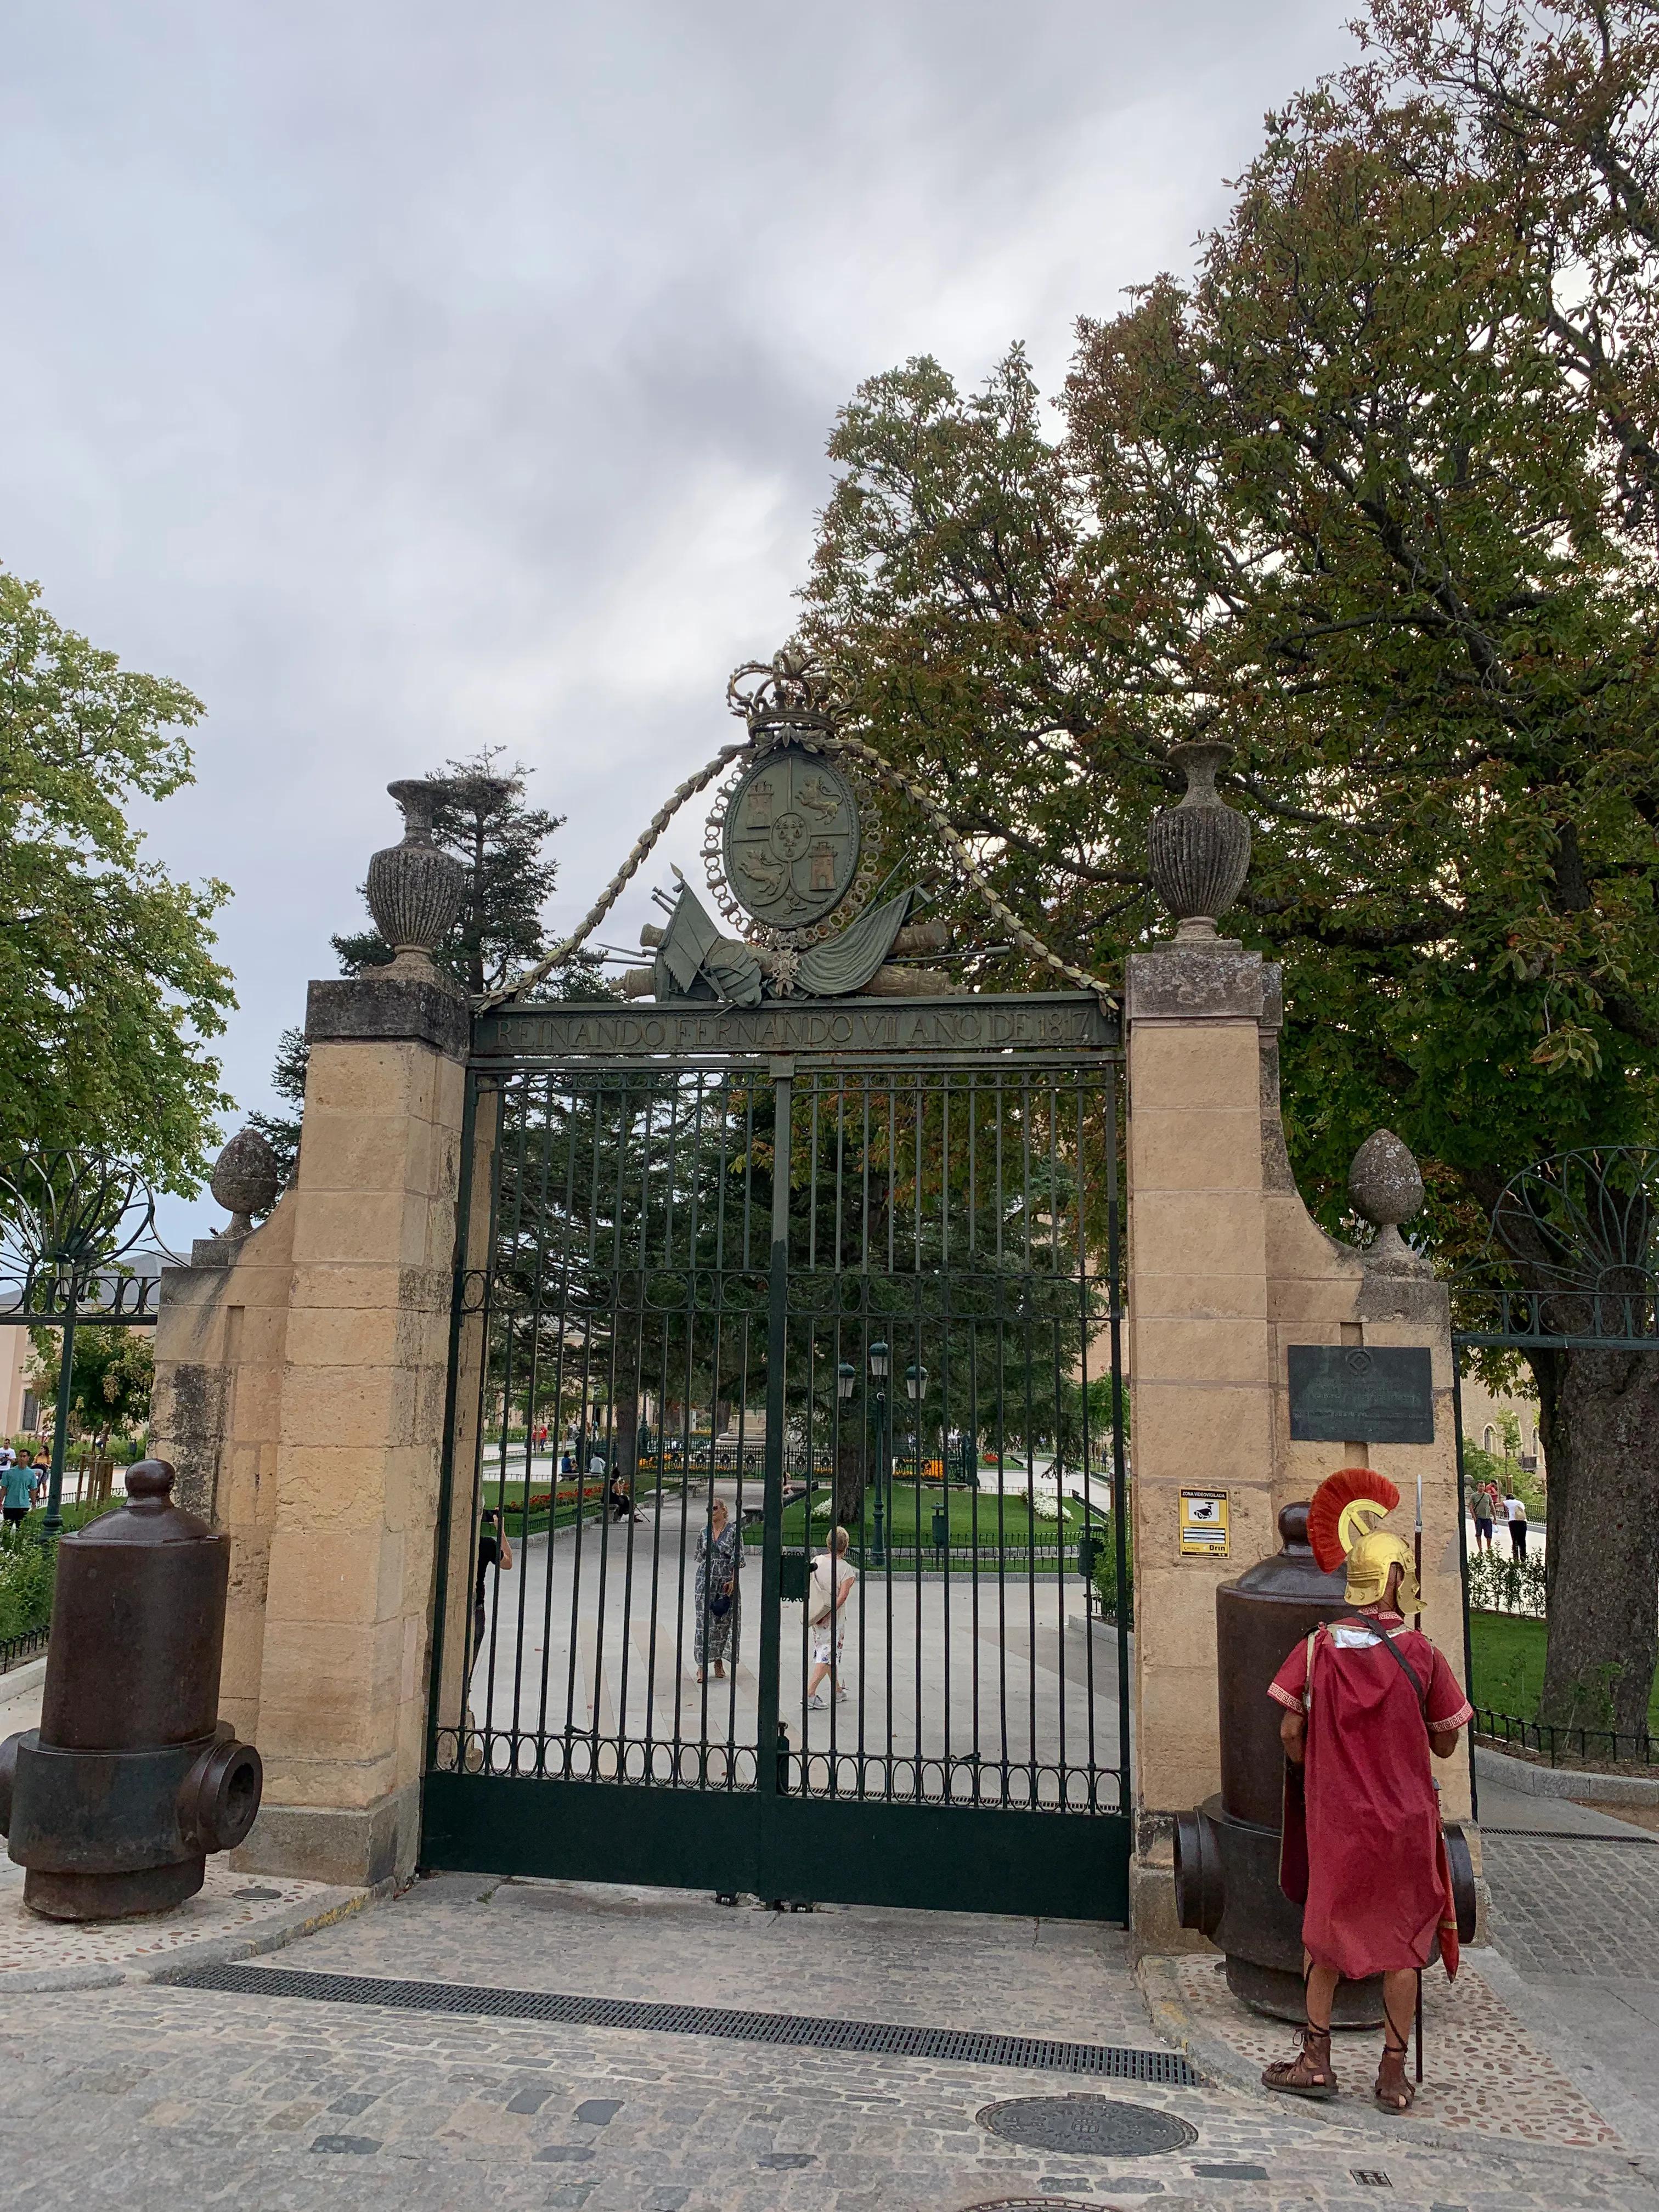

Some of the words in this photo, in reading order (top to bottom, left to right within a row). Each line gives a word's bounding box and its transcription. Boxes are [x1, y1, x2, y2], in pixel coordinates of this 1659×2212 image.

[494, 1019, 665, 1048] REINANDO
[674, 1015, 853, 1046] FERNANDO
[859, 1015, 900, 1043] VII
[905, 1012, 981, 1043] AÑO
[987, 1013, 1032, 1042] DE
[1037, 1011, 1089, 1041] 1817
